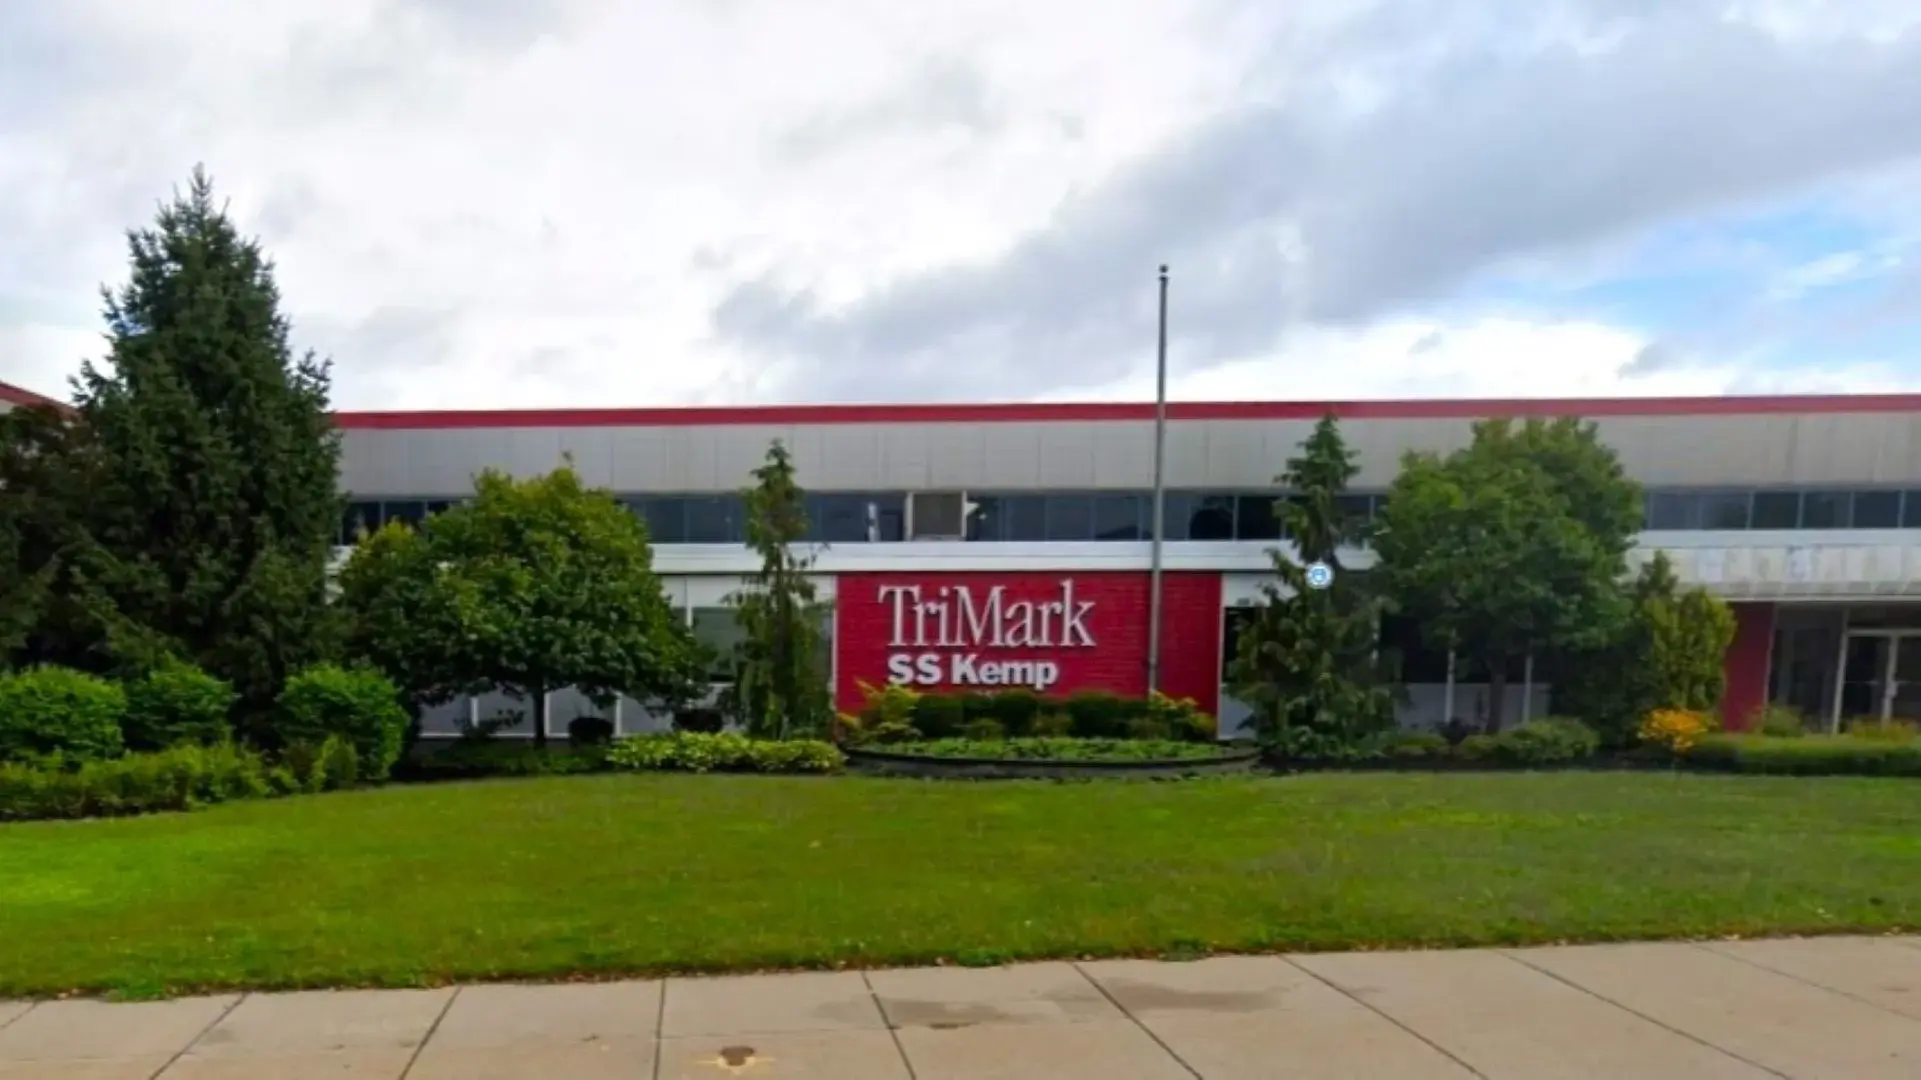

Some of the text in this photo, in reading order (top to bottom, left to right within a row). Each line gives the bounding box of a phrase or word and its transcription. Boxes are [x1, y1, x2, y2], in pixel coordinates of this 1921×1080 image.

[878, 578, 1096, 647] TriMark
[888, 654, 1058, 690] SS Kemp
